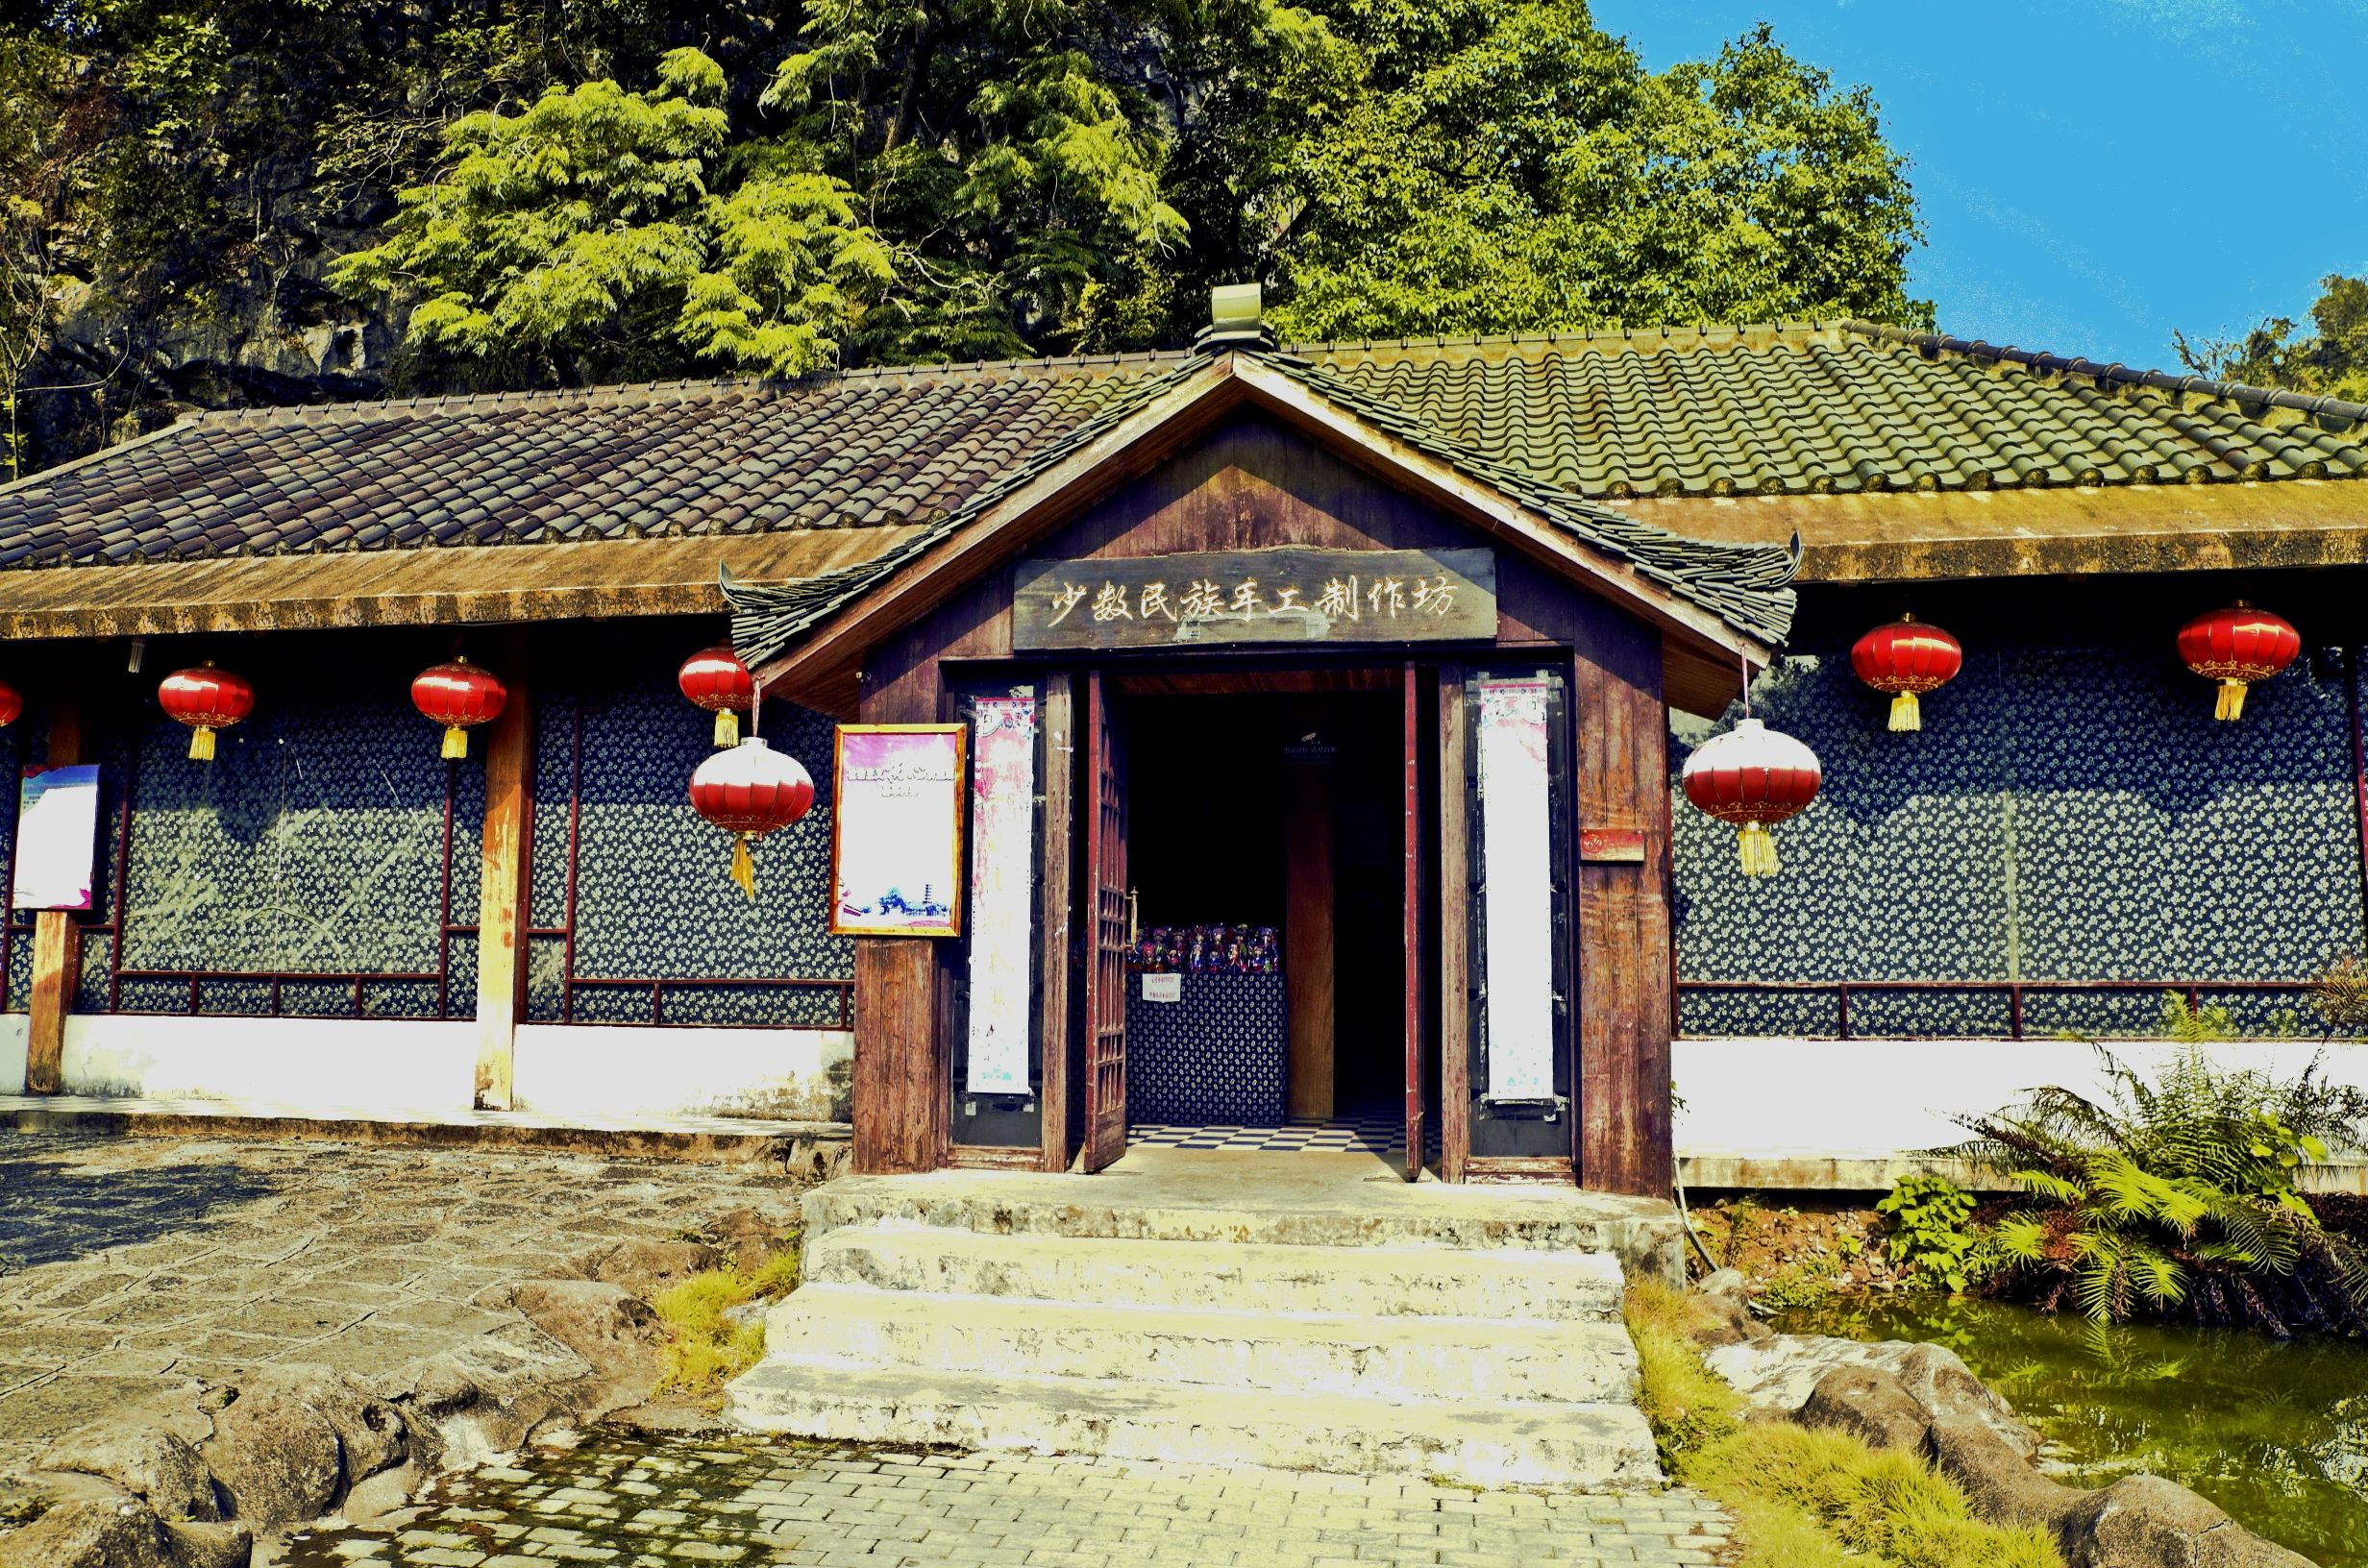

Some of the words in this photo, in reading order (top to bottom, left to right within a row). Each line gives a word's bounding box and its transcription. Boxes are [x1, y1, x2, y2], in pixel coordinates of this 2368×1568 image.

[1048, 575, 1459, 627] 少数民族手工制作坊
